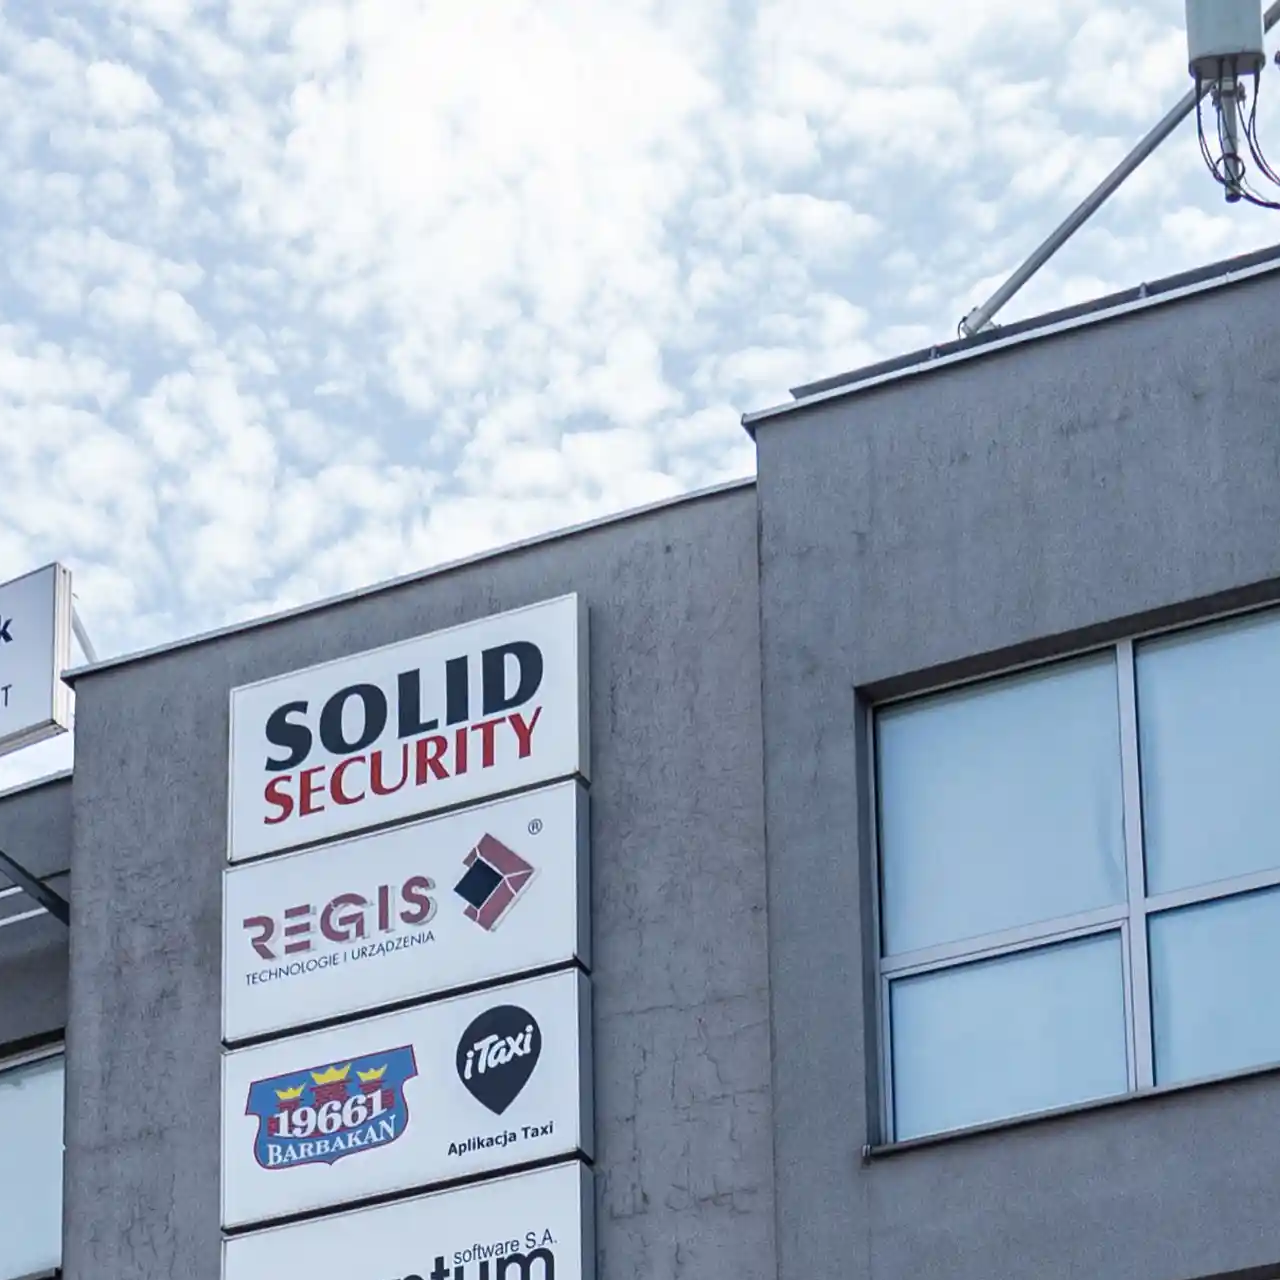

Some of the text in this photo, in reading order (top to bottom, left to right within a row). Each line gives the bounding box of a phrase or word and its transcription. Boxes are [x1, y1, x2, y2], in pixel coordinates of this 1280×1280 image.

[264, 640, 544, 771] SOLID
[263, 706, 543, 825] SECURITY
[243, 875, 437, 960] REGIS
[246, 951, 340, 986] TECHNOLOGIE
[351, 930, 435, 961] URZĄDZENIA
[463, 1024, 534, 1080] iTaxi
[266, 1114, 397, 1166] BARBAKAN
[273, 1089, 387, 1139] 19661
[448, 1121, 554, 1156] Aplikacja Taxi
[453, 1228, 557, 1265] software S.A.
